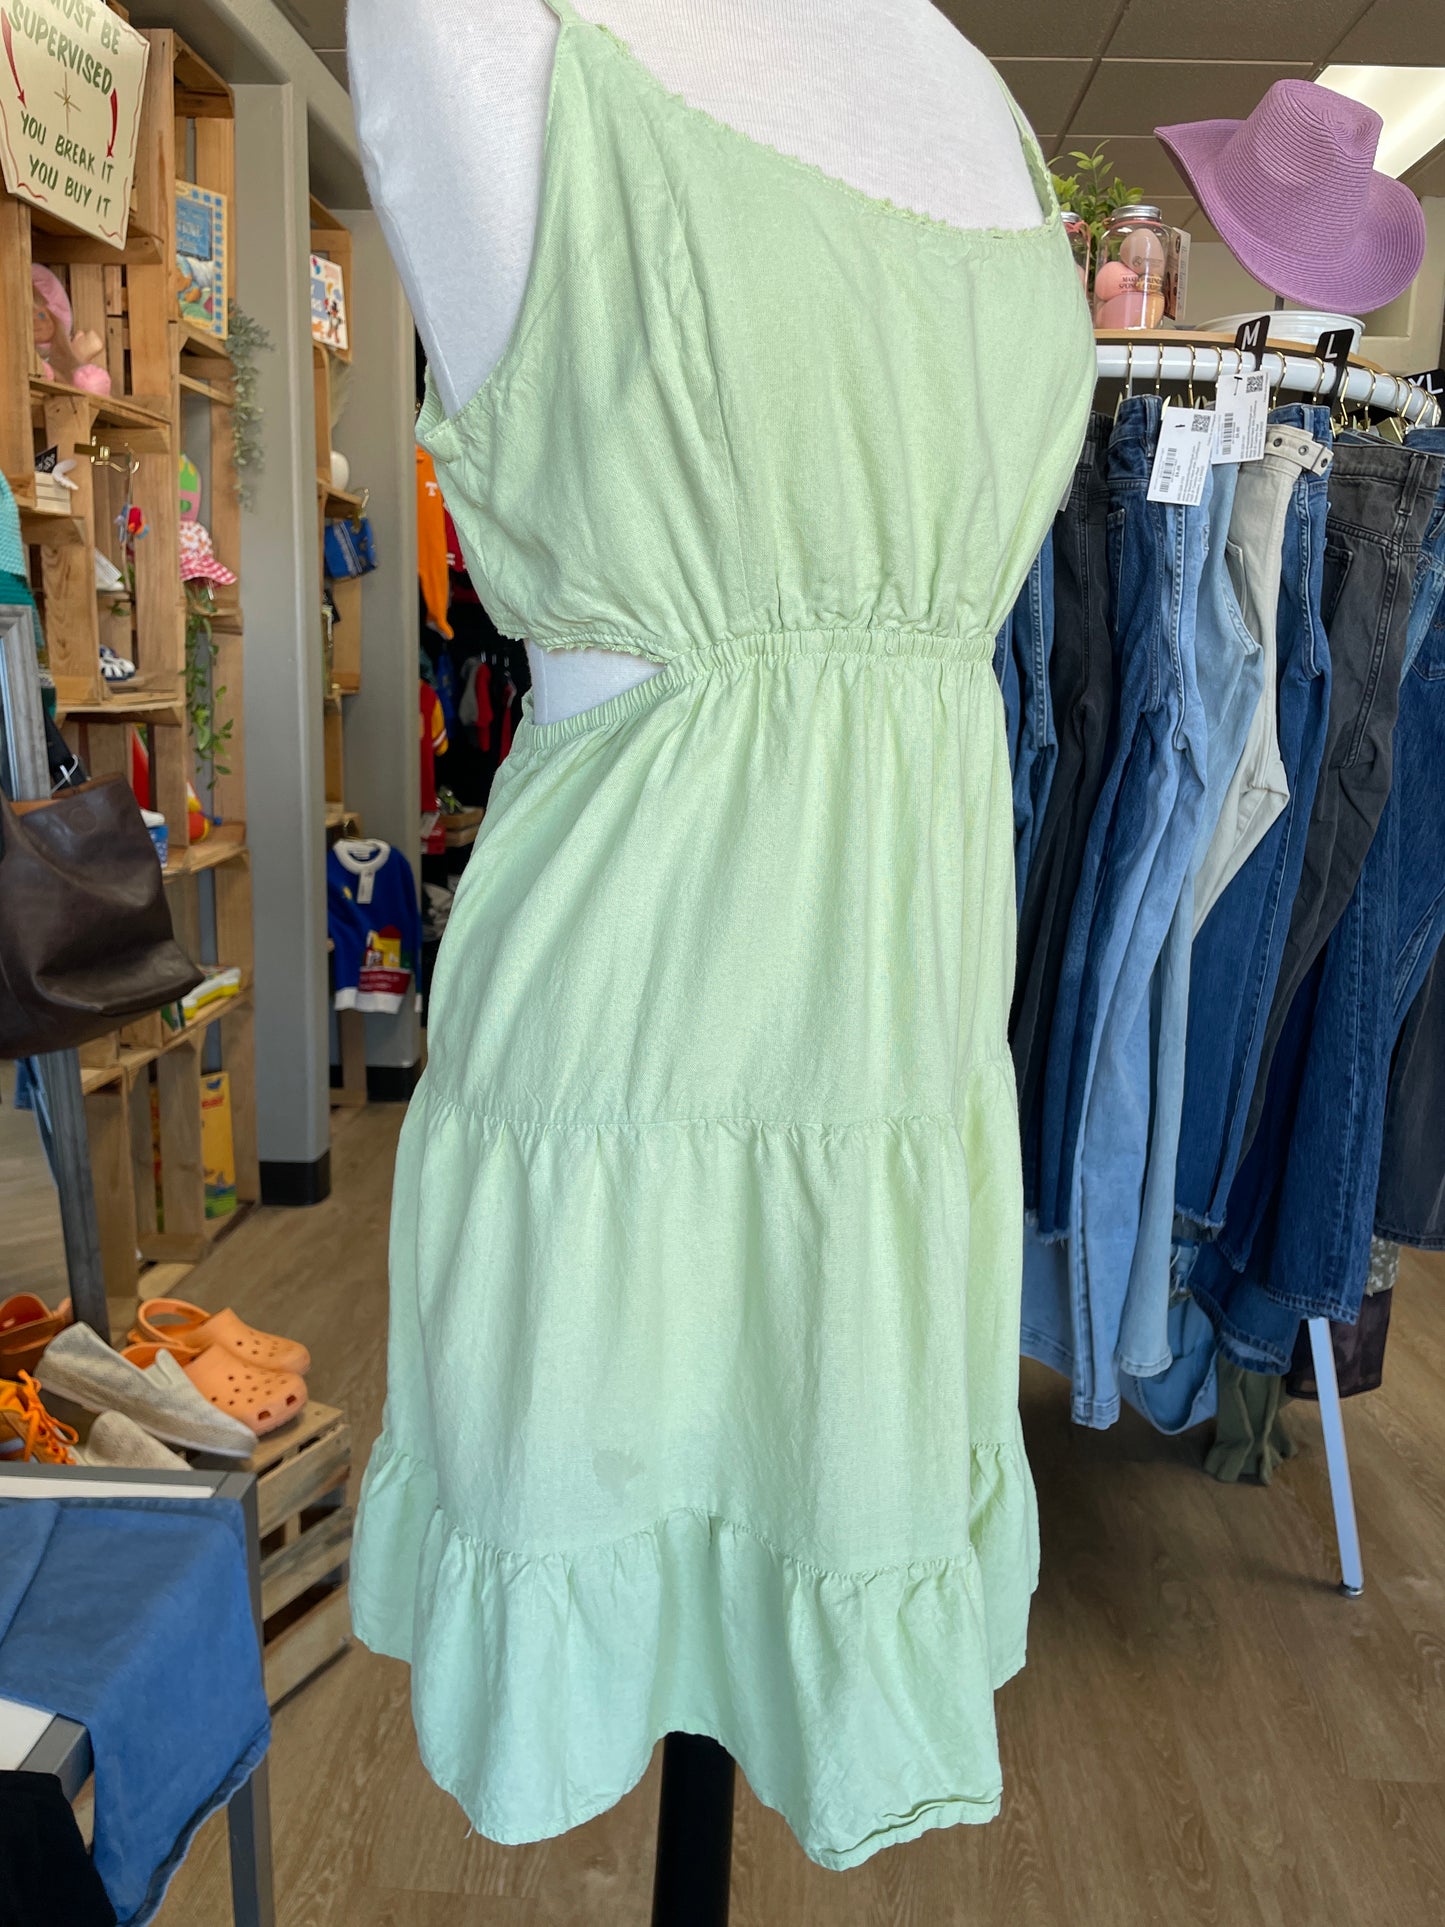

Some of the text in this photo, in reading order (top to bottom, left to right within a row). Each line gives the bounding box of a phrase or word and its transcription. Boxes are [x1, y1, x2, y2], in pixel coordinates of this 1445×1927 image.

[8, 0, 113, 95] SUPERVISED
[51, 0, 121, 55] UST BE
[20, 110, 114, 184] YOU BREAK IT
[29, 154, 112, 218] YOU BUY IT
[1241, 321, 1261, 350] M
[1325, 333, 1338, 359] L
